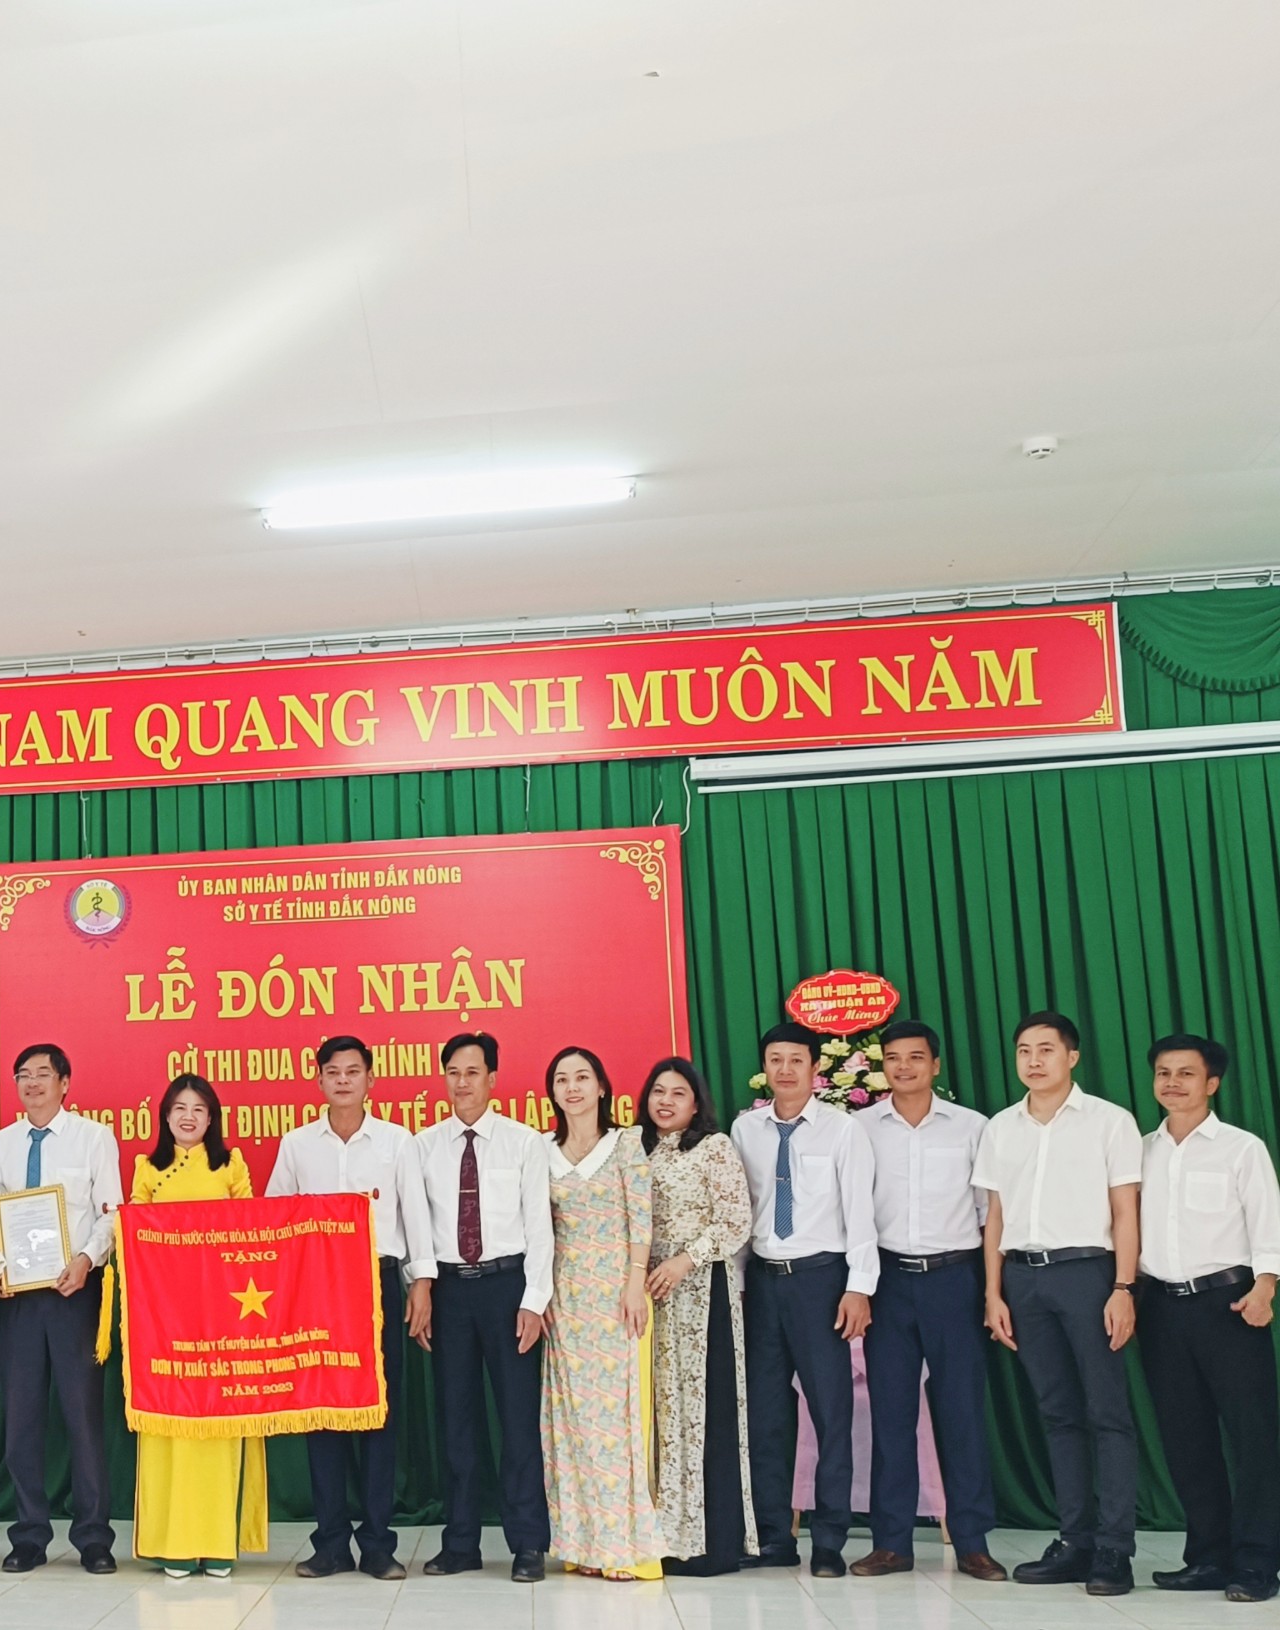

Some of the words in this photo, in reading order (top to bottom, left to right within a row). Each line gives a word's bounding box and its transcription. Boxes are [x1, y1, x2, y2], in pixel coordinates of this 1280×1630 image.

[134, 689, 380, 770] QUANG
[400, 675, 585, 739] VINH
[607, 646, 835, 730] MUÔN
[859, 635, 1042, 714] NĂM
[178, 875, 199, 897] ỦY
[202, 878, 237, 896] BAN
[241, 872, 288, 894] NHÂN
[292, 870, 327, 892] DÂN
[331, 866, 370, 890] TỈNH
[374, 863, 409, 888] ĐẮK
[413, 864, 462, 885] NÔNG
[223, 899, 246, 922] SỞ
[249, 904, 259, 921] Y
[263, 898, 283, 920] TẾ
[286, 896, 325, 919] TỈNH
[328, 894, 364, 917] ĐẮK
[367, 894, 416, 916] NÔNG
[125, 946, 196, 1021] LỄ
[216, 953, 337, 1018] ĐÓN
[357, 945, 525, 1023] NHẬN
[867, 995, 886, 1006] AN
[807, 1009, 838, 1024] Chúc
[841, 1008, 880, 1021] Mừng
[167, 1043, 198, 1082] CỜ
[204, 1049, 241, 1082] THI
[247, 1048, 295, 1081] ĐUA
[370, 1037, 431, 1078] HÍNH
[120, 1096, 152, 1140] BỐ
[236, 1105, 295, 1145] ĐỊNH
[399, 1090, 428, 1132] TẾ
[137, 1227, 162, 1244] CHÍNH
[164, 1228, 180, 1245] PHỦ
[182, 1229, 204, 1245] NƯỚC
[205, 1228, 228, 1247] CỘNG
[247, 1227, 260, 1243] XÃ
[260, 1226, 275, 1244] HỘI
[276, 1221, 293, 1240] CHỦ
[293, 1217, 319, 1236] NGHĨA
[318, 1218, 337, 1236] VIỆT
[338, 1221, 356, 1233] NAM
[221, 1250, 279, 1264] TẶNG
[173, 1360, 183, 1379] VỊ
[184, 1357, 207, 1377] XUẤT
[231, 1359, 265, 1375] TRONG
[265, 1355, 297, 1374] PHONG
[296, 1349, 321, 1368] TRÀO
[322, 1350, 339, 1366] THI
[222, 1383, 259, 1397] NĂM
[262, 1381, 294, 1394] 2023
